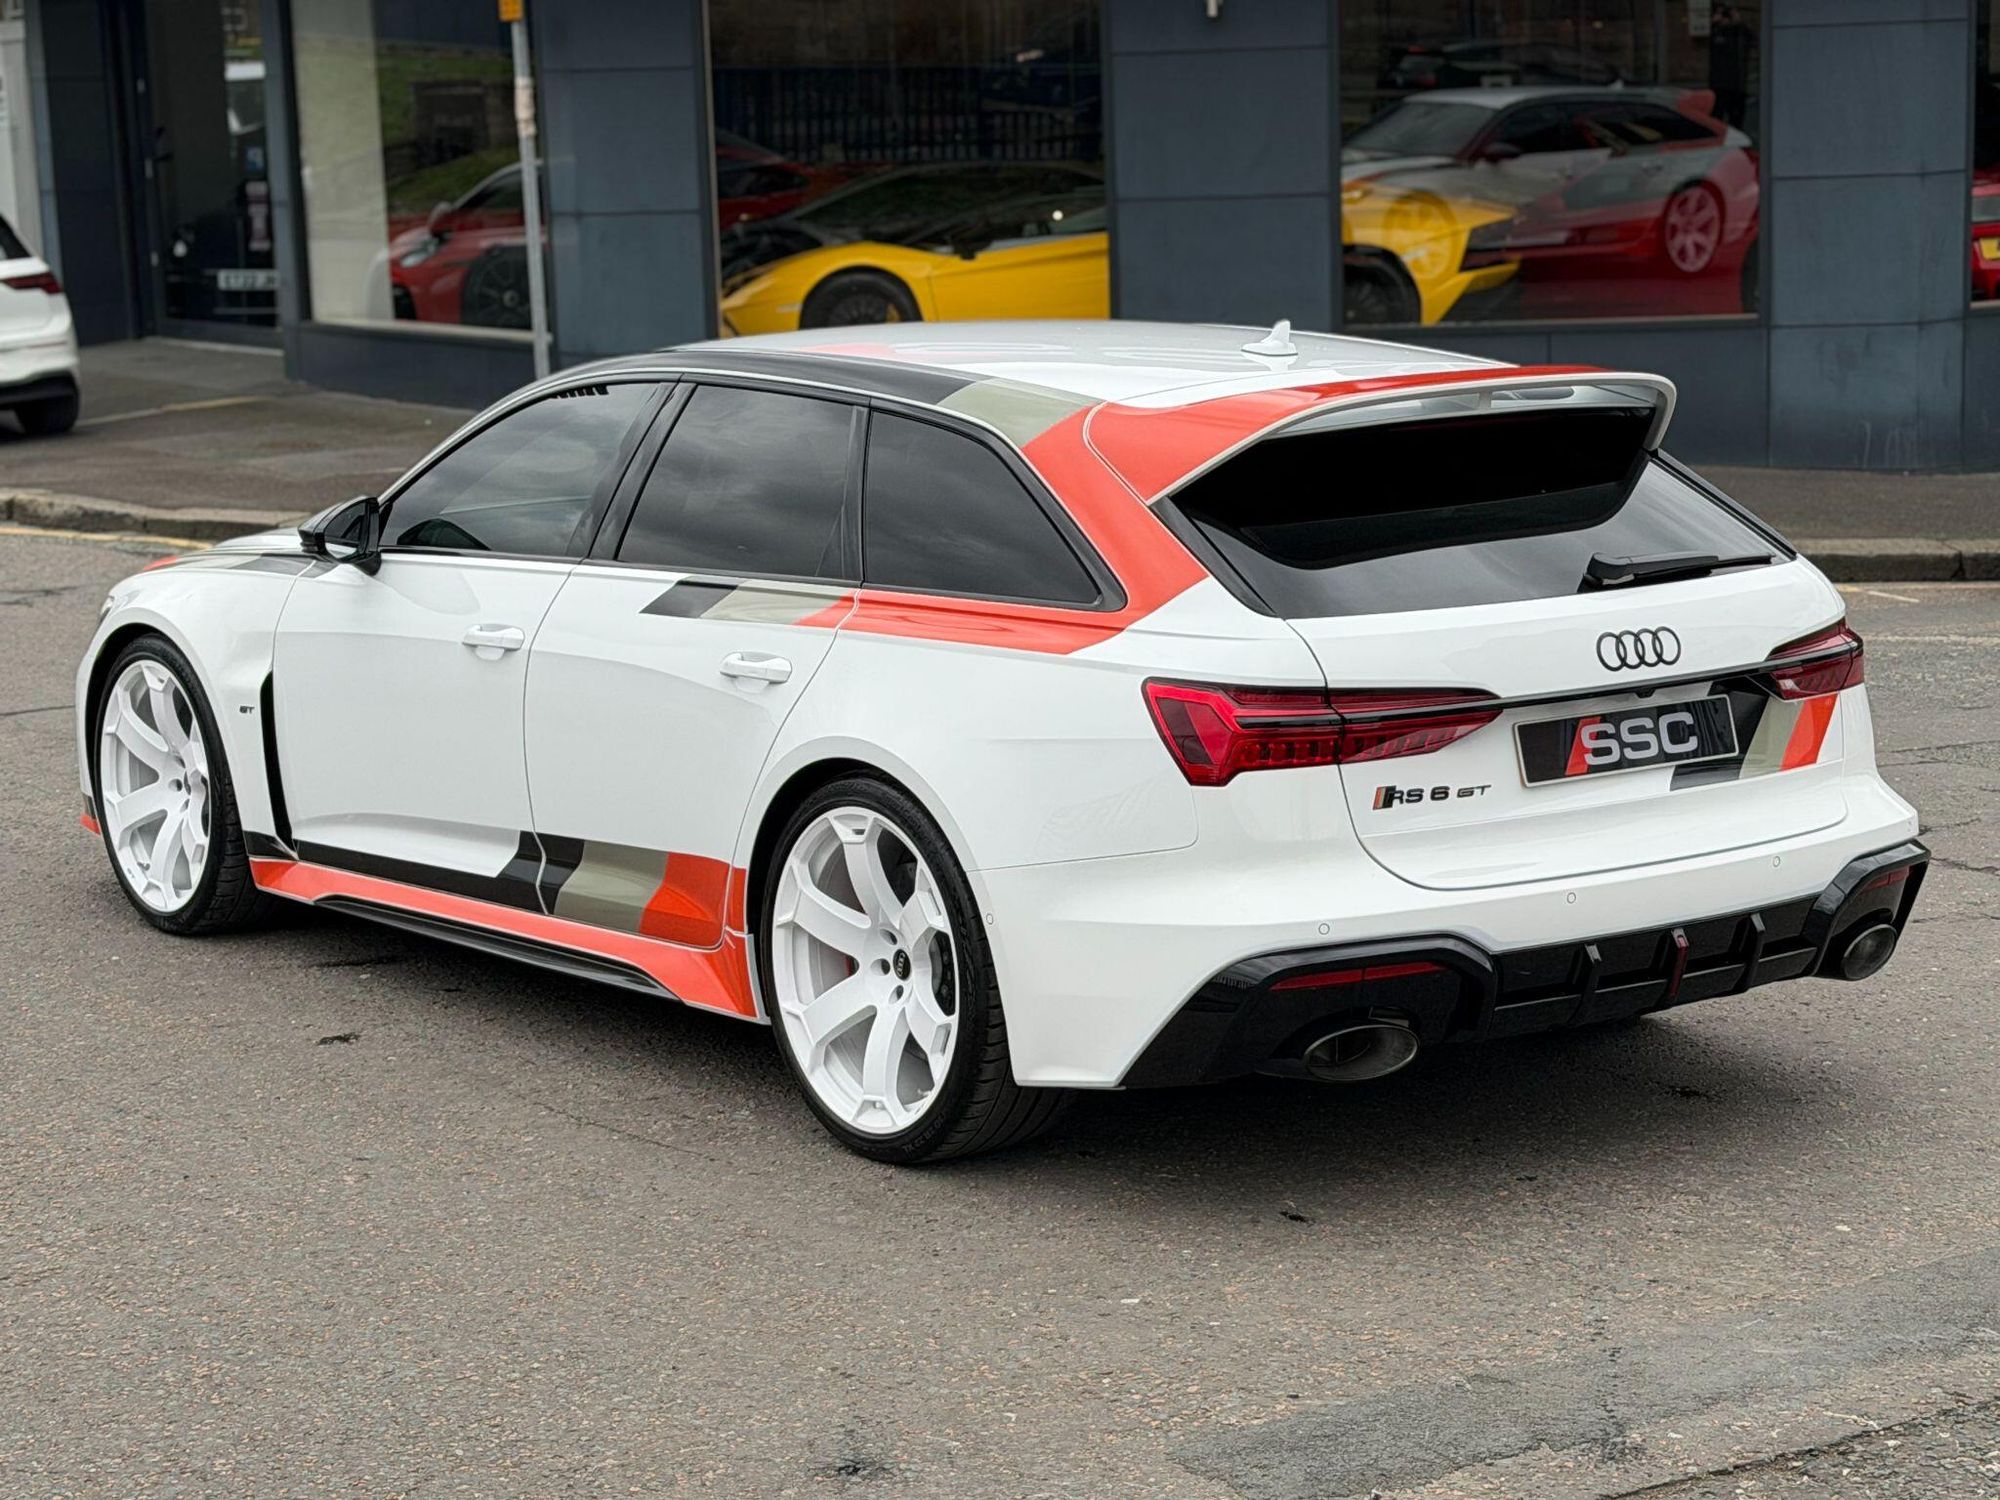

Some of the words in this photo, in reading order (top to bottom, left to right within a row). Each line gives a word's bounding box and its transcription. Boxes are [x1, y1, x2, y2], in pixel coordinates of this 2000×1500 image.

[1580, 712, 1698, 765] SSC
[1386, 787, 1424, 805] RS
[1430, 785, 1450, 801] 6
[1457, 784, 1491, 798] GT
